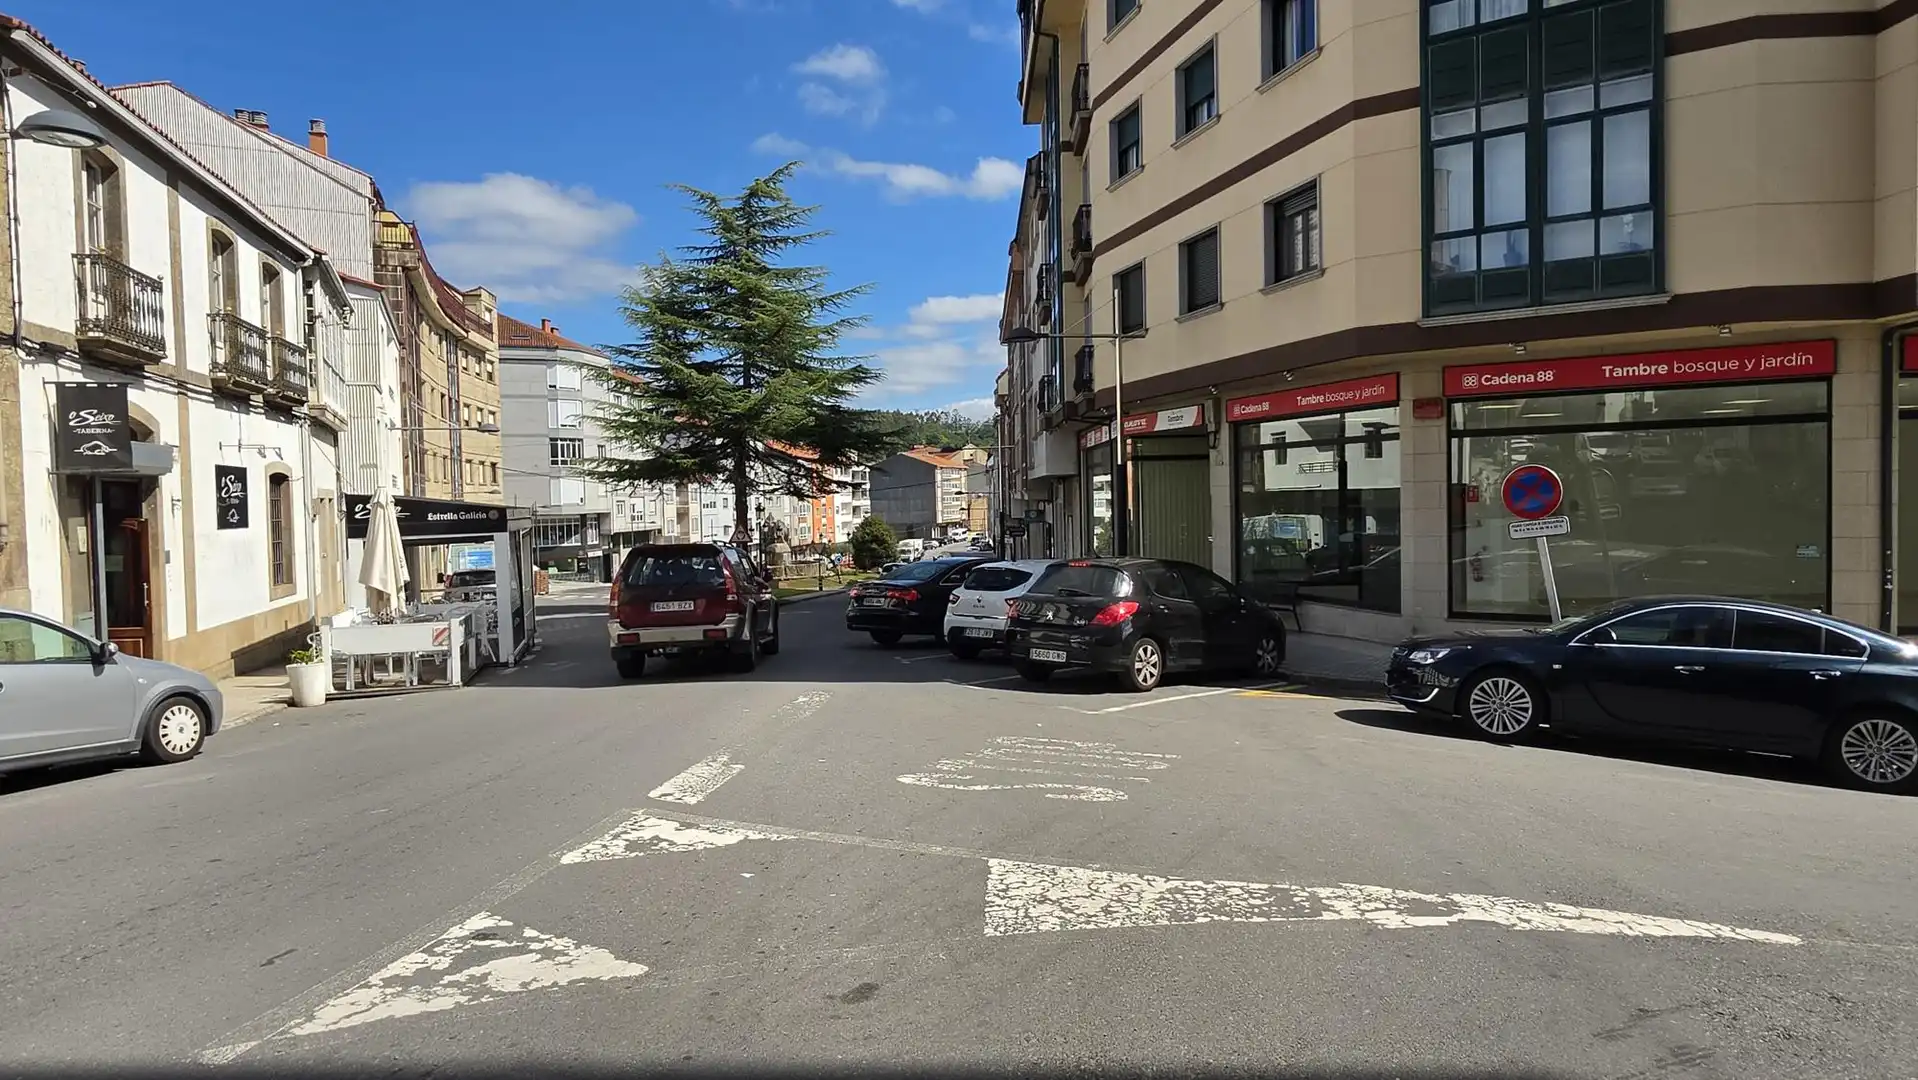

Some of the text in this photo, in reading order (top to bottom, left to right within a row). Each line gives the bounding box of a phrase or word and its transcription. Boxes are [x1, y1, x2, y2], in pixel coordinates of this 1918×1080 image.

[1602, 352, 1813, 378] Tambre bosque y jardín
[1481, 372, 1535, 386] Cadena
[1536, 370, 1554, 382] 88
[1297, 384, 1386, 407] Tambre bosque y jardín
[1240, 404, 1262, 414] Cadena
[69, 409, 121, 426] Seixo
[77, 427, 112, 435] TABERNA
[427, 511, 487, 521] Estrella Galicia
